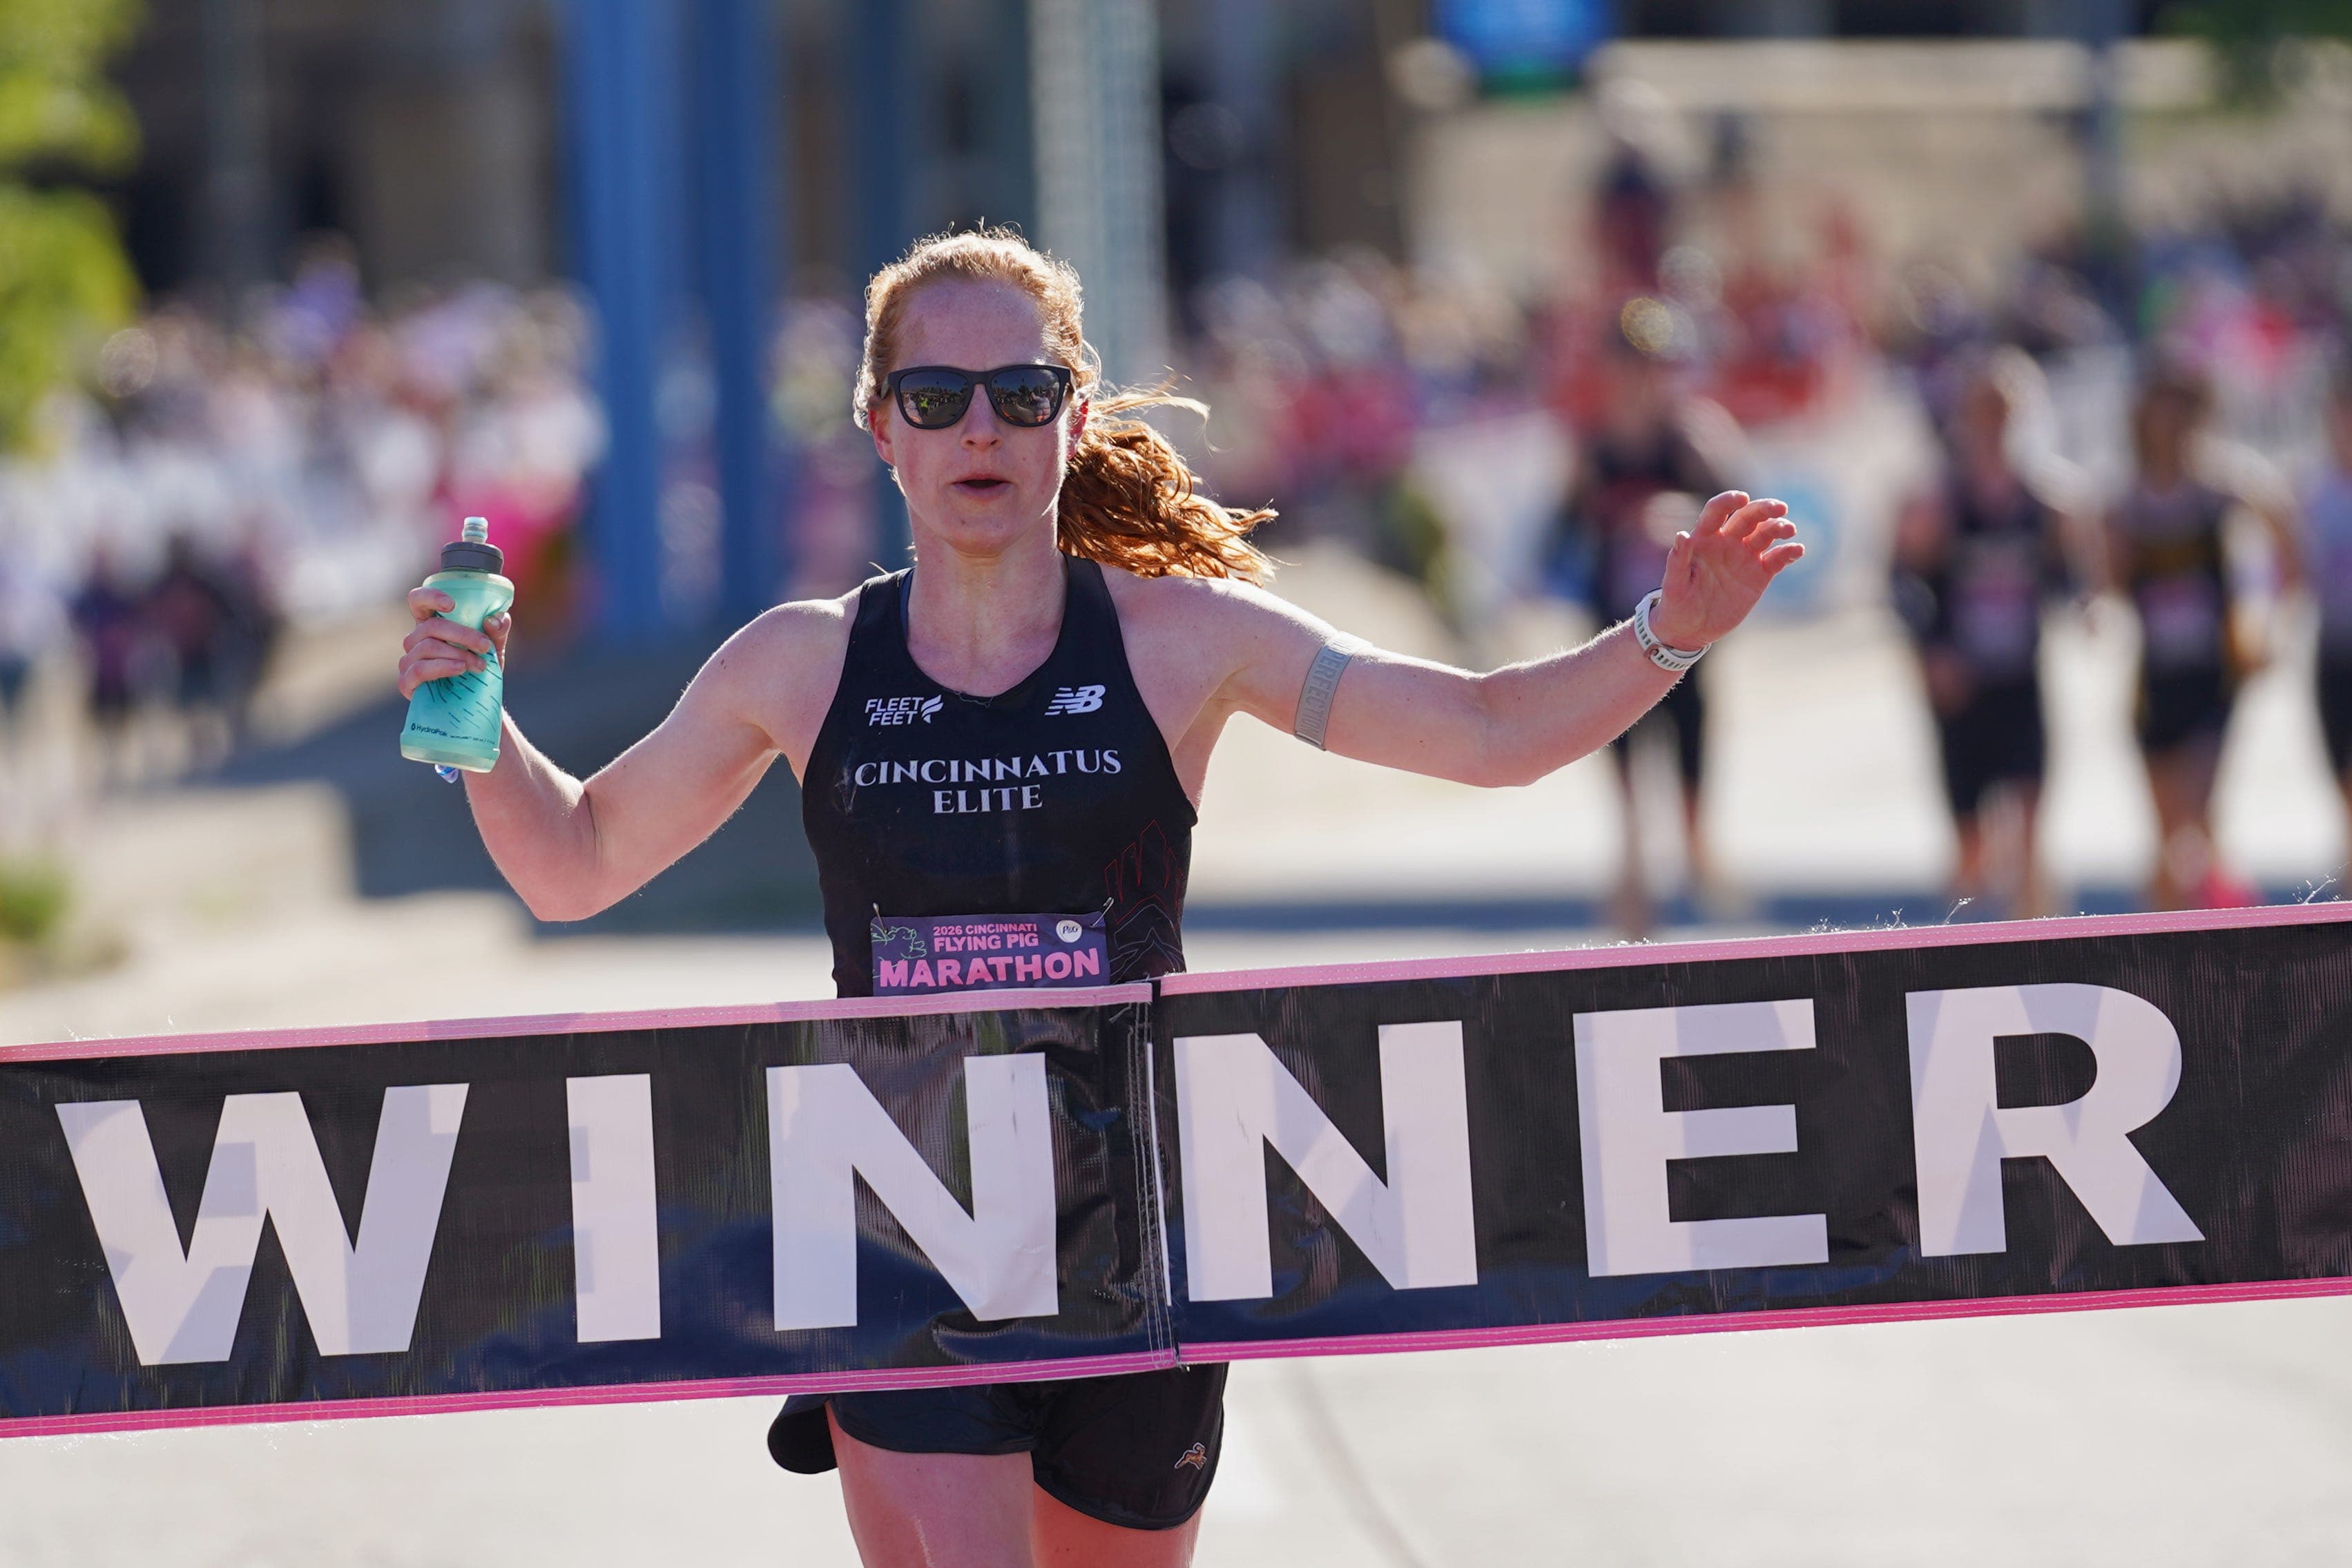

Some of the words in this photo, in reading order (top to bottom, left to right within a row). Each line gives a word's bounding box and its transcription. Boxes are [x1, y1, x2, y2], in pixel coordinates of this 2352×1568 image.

[865, 697, 924, 713] FLEET
[869, 710, 918, 726] FEET
[854, 749, 1121, 787] CINCINNATUS
[933, 784, 1043, 814] ELITE
[933, 926, 963, 936] 2026
[965, 923, 1037, 933] CINCINNATI
[1063, 925, 1079, 934] P&G
[934, 934, 1001, 952] FLYING
[1007, 933, 1039, 948] PIG
[879, 948, 1100, 987] MARATHON
[55, 983, 2206, 1366] WINNER
